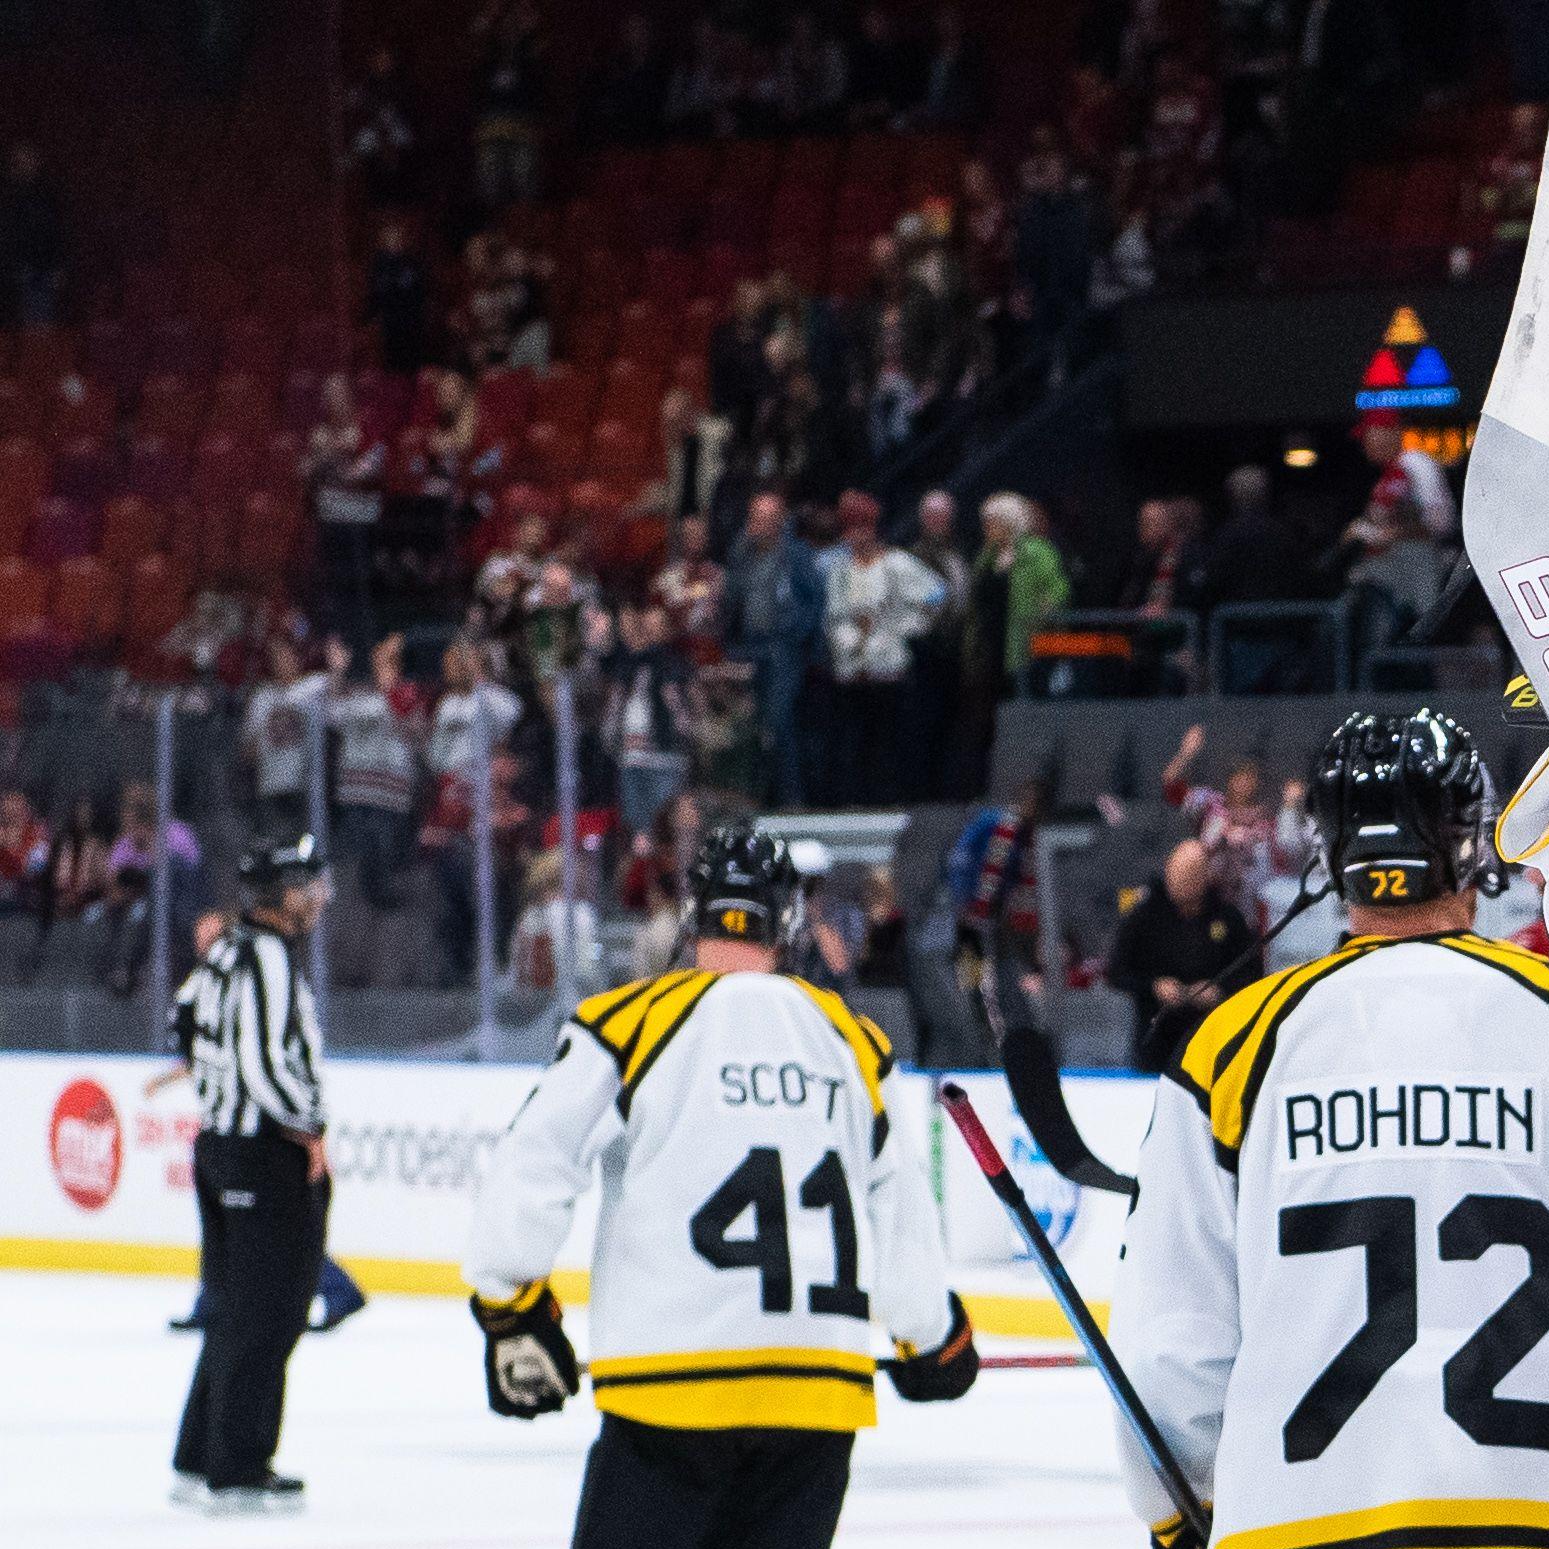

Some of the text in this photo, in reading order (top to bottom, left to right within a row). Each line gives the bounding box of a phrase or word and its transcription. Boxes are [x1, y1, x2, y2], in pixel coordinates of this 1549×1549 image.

[1369, 869, 1410, 898] 72
[1285, 1084, 1534, 1161] ROHDIN
[689, 1146, 869, 1320] 41
